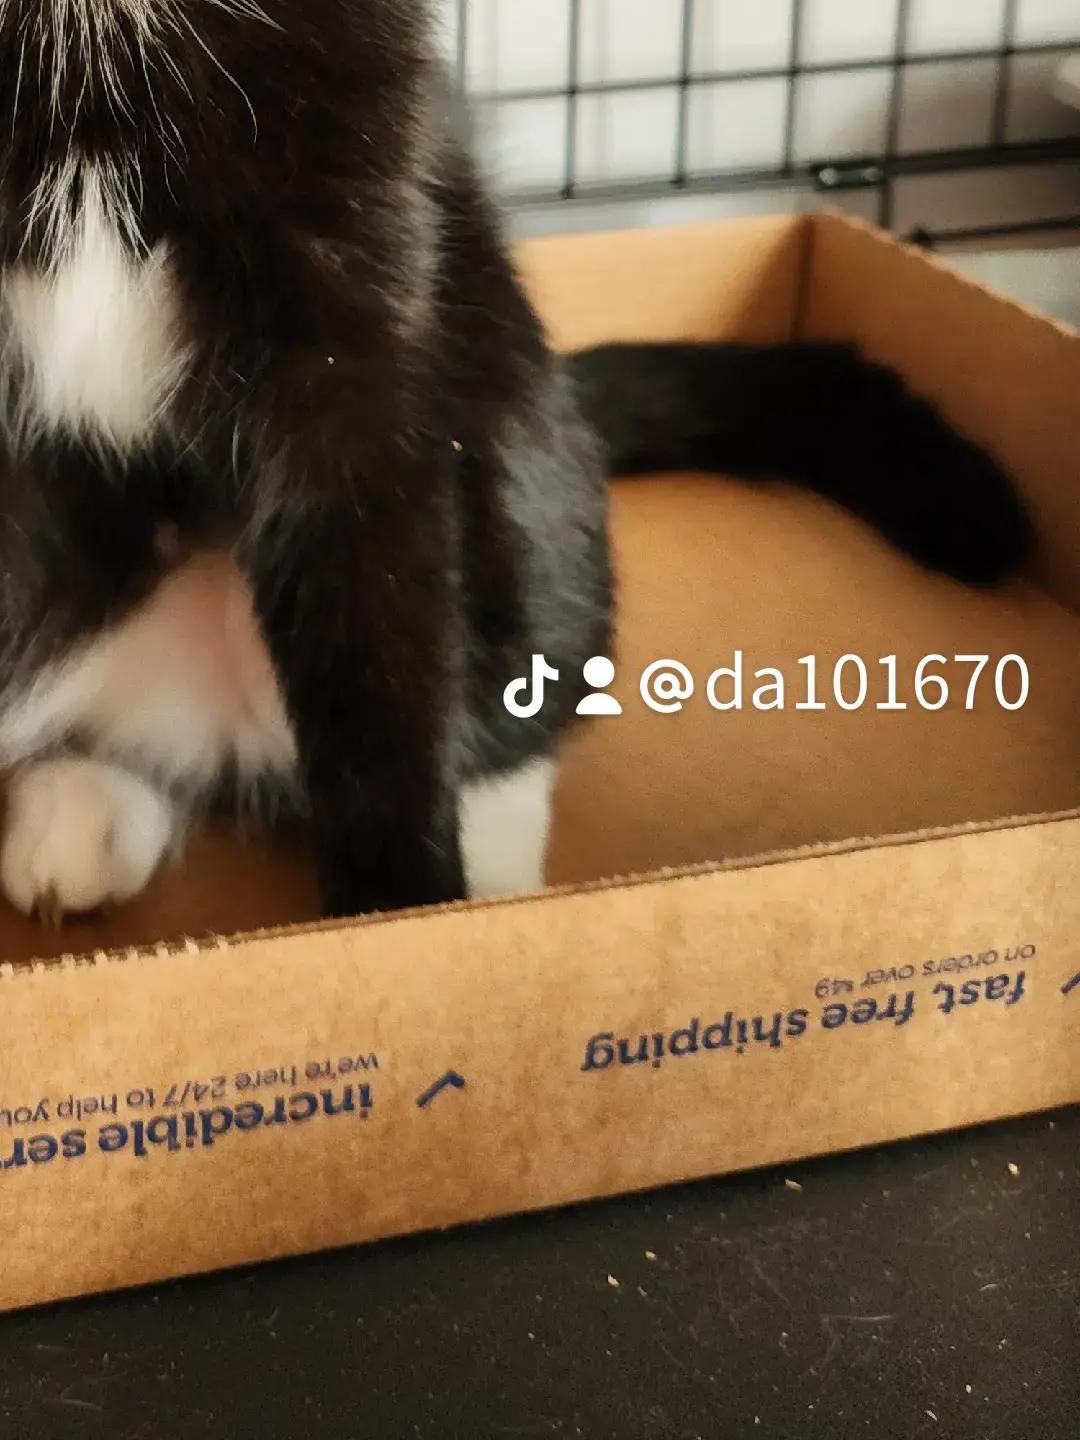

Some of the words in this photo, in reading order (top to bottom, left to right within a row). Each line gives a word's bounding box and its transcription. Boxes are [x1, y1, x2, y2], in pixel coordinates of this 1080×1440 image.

[922, 949, 998, 977] orders
[1003, 944, 1036, 965] on
[860, 964, 916, 988] over
[931, 970, 1027, 1014] fast,
[821, 990, 916, 1029] free
[580, 1008, 809, 1071] shipping
[235, 1063, 297, 1090] here
[304, 1052, 380, 1080] we're
[56, 1092, 118, 1119] help
[126, 1086, 156, 1109] to
[163, 1076, 223, 1108] 24/7
[98, 1082, 373, 1157] incredible
